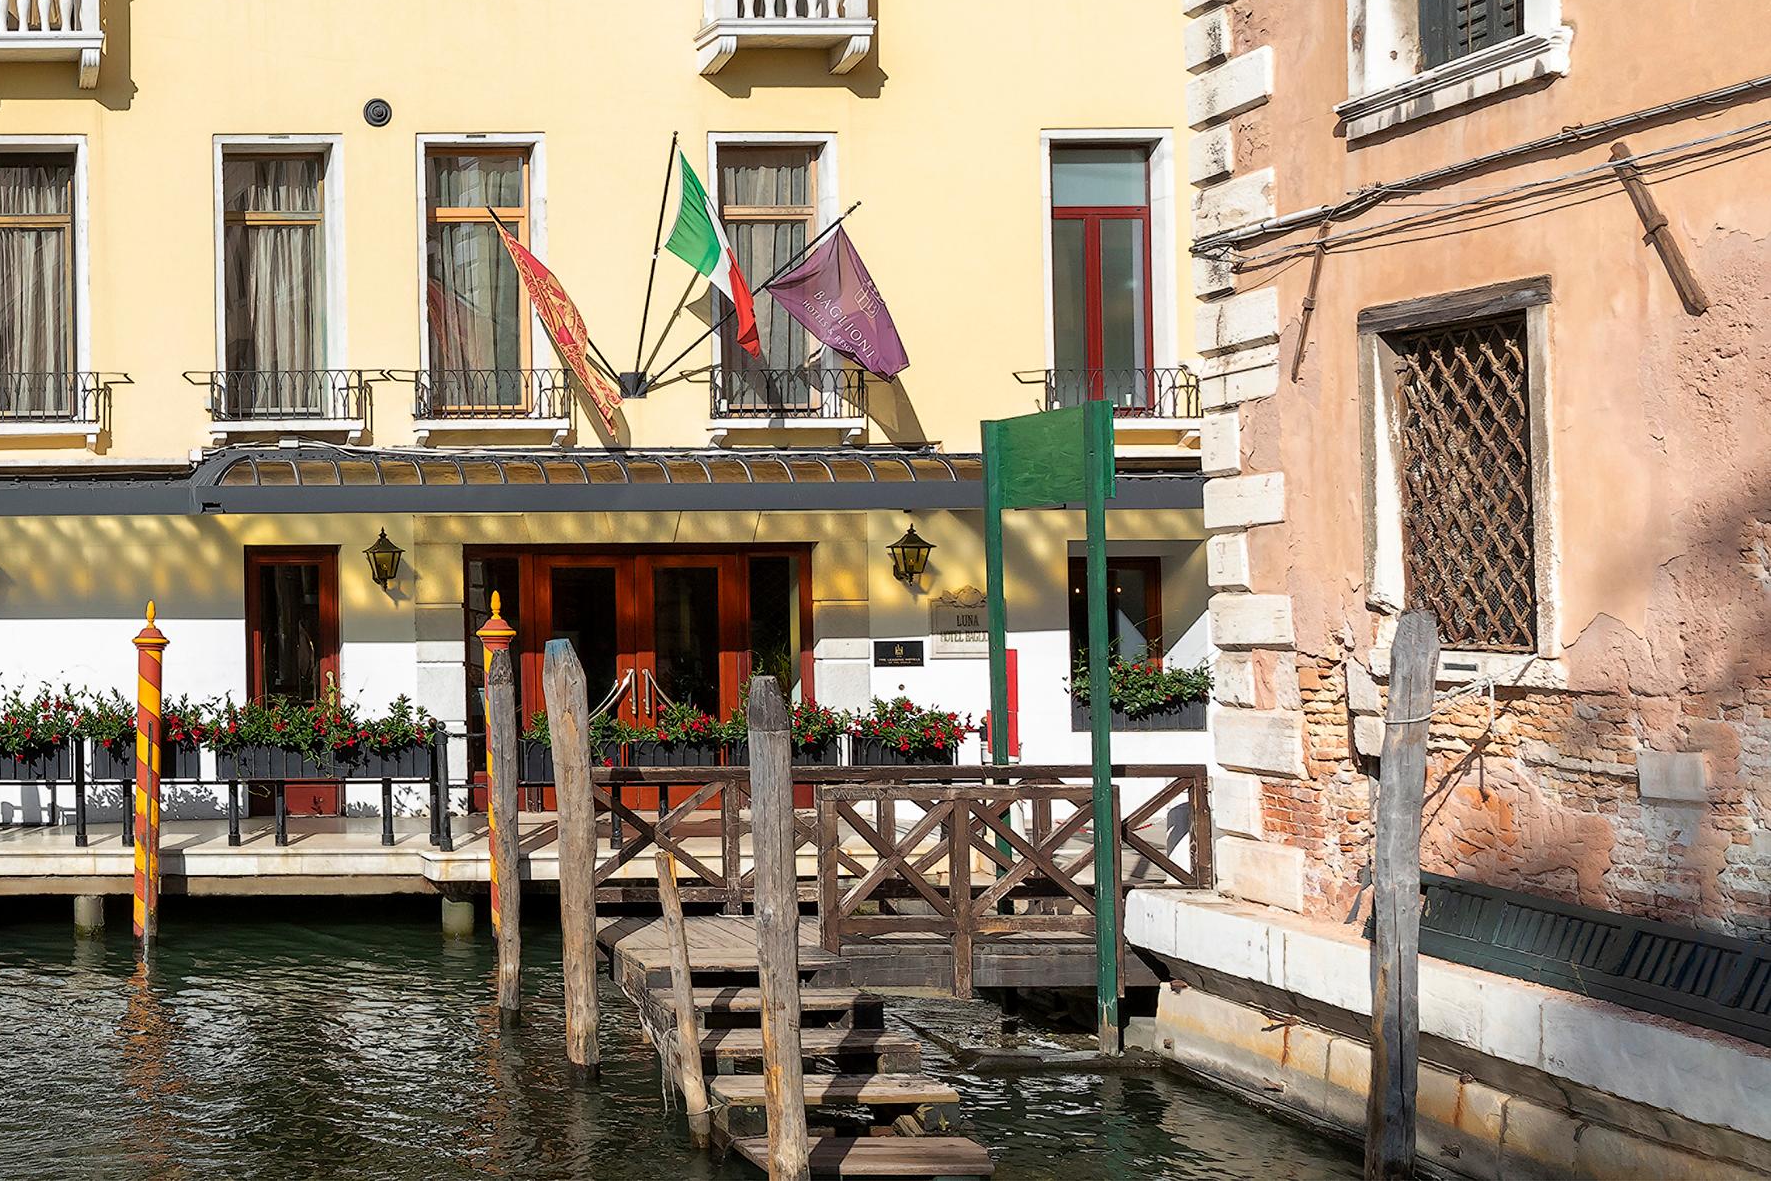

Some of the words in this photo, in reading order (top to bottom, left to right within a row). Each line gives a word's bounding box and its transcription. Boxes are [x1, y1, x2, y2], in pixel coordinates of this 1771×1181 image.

[802, 300, 829, 327] HOTELS
[827, 326, 835, 336] &
[813, 290, 875, 358] BAGLIONI
[956, 615, 980, 627] LUNA
[940, 630, 964, 642] HOTEL
